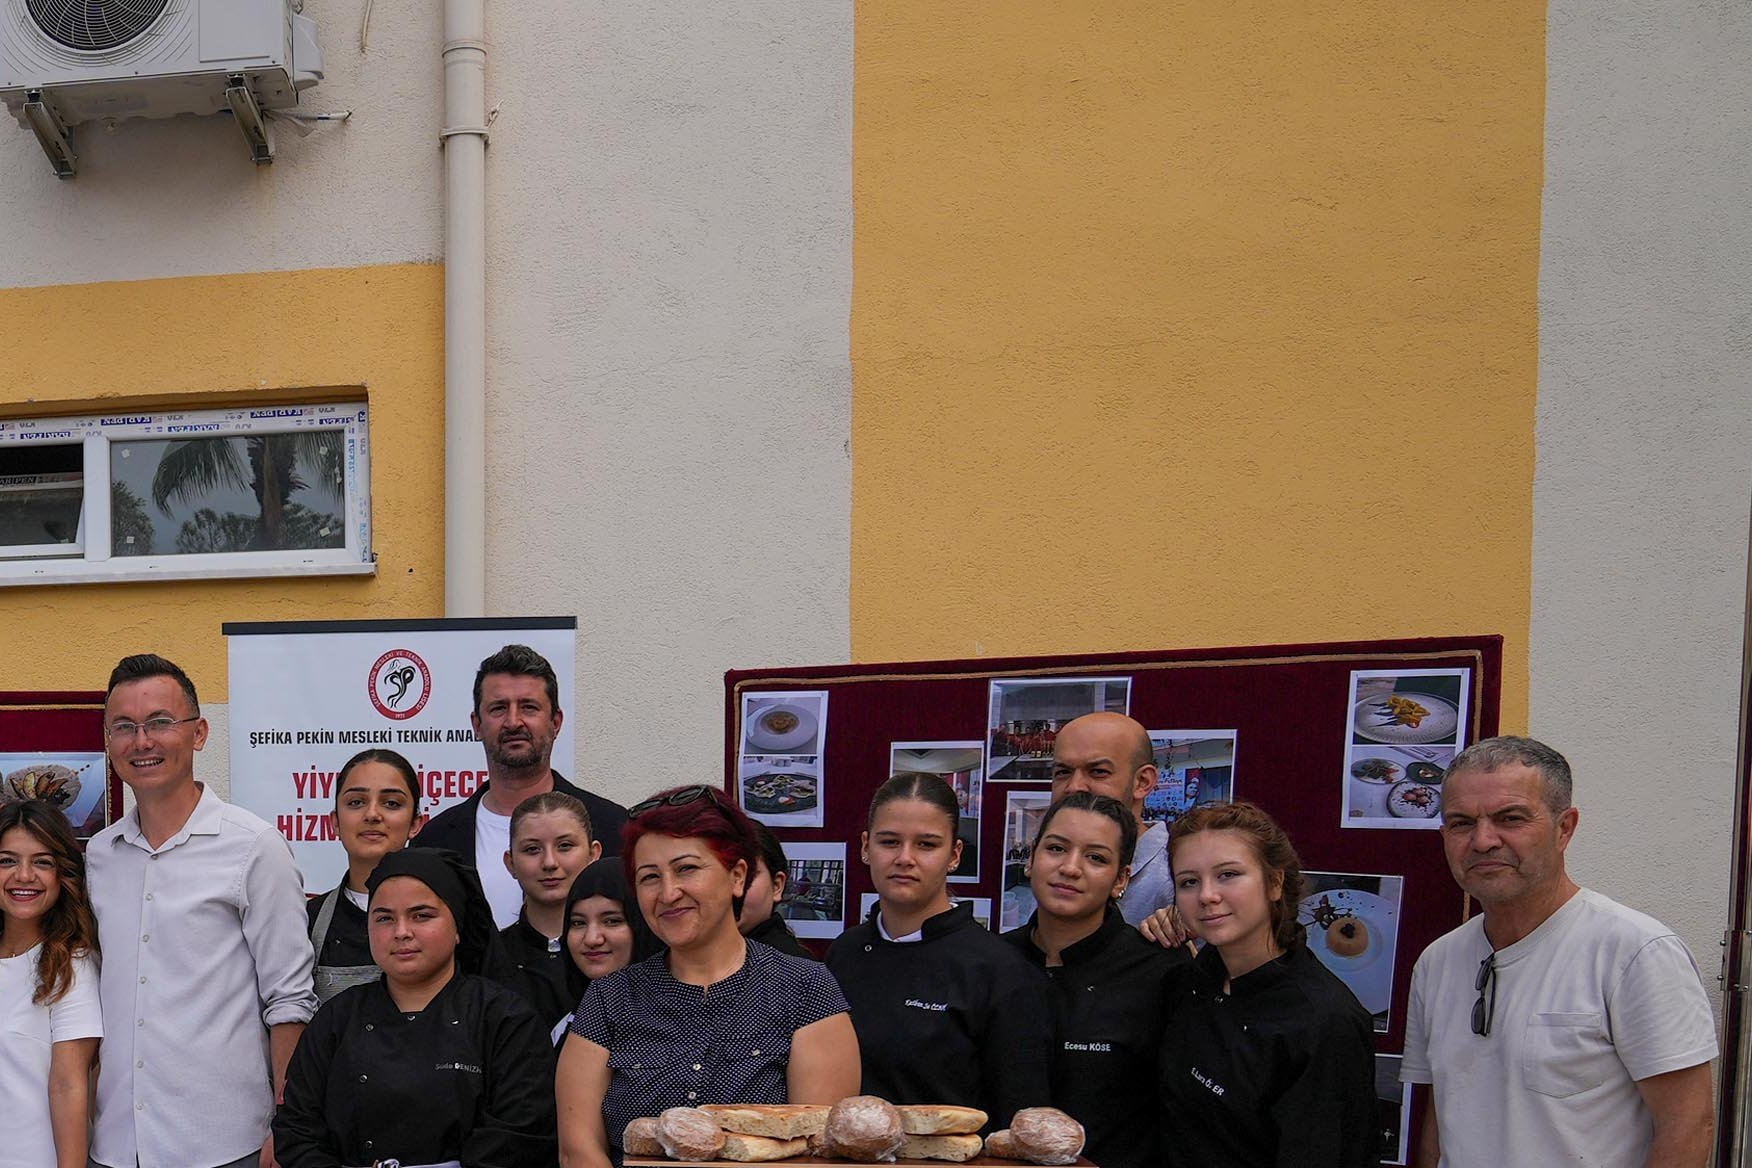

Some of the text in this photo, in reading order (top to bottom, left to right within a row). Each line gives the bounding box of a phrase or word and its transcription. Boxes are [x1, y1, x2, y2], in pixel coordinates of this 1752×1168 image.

[249, 729, 292, 748] ŞEFİKA
[297, 728, 335, 744] PEKİN
[339, 727, 392, 744] MESLEKİ
[397, 727, 442, 743] TEKNİK
[1064, 1042, 1088, 1051] Ecesu
